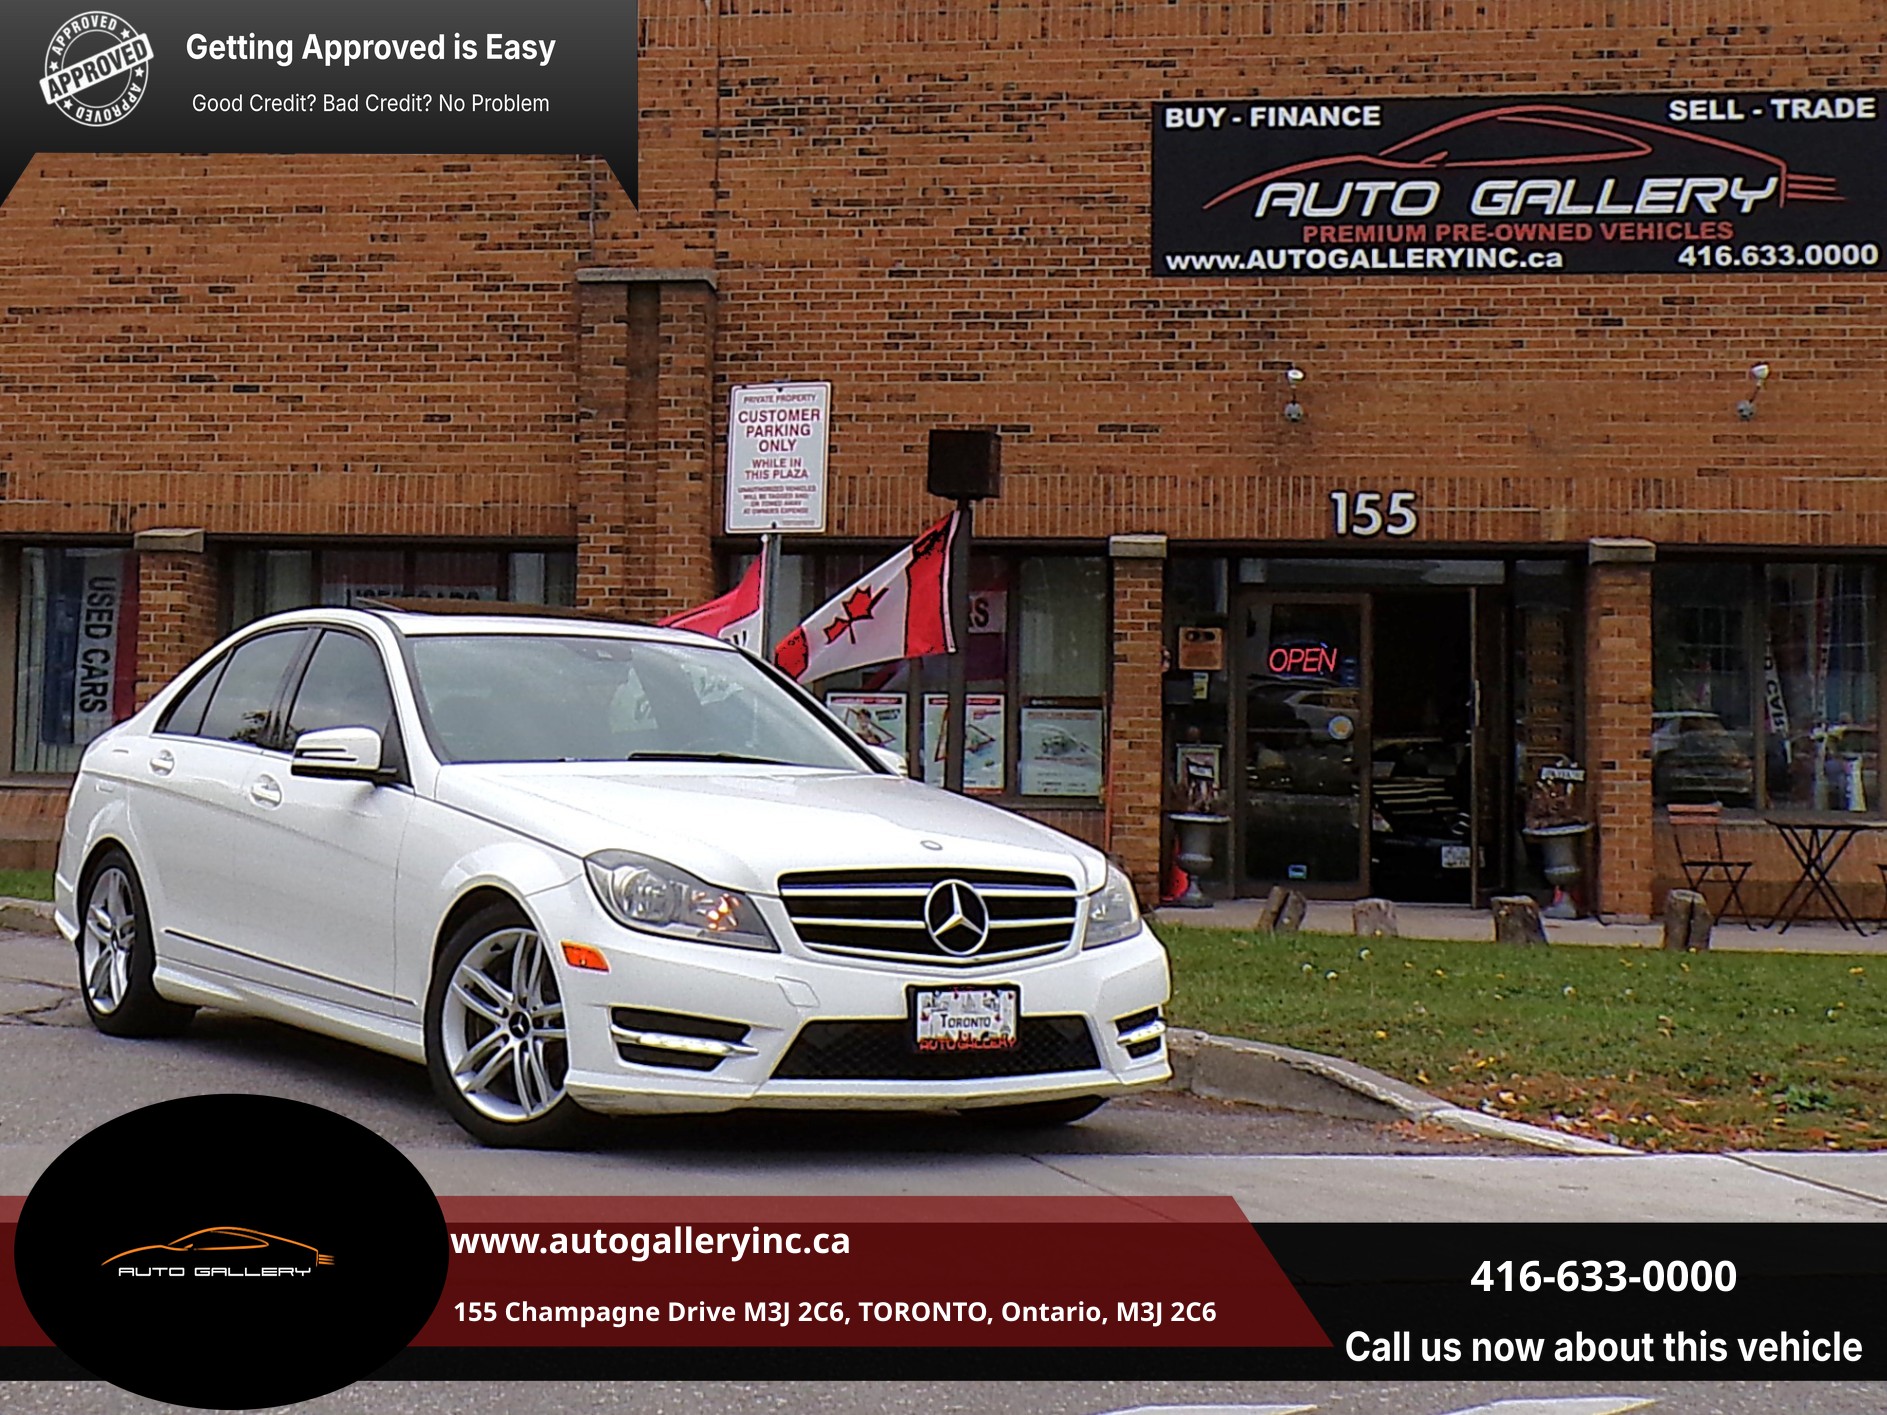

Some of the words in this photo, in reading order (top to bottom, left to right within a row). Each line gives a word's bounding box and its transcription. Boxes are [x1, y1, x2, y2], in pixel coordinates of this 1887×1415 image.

[1165, 107, 1227, 128] BUY
[1250, 105, 1381, 127] FINANCE
[1669, 99, 1745, 121] SELL
[1771, 97, 1876, 119] TRADE
[1255, 181, 1440, 217] AUTO
[1471, 177, 1778, 216] GALLERY
[1303, 223, 1426, 243] PREMIUM
[1436, 222, 1592, 242] PRE-OWNED
[1600, 221, 1734, 240] VEHICLES
[1165, 248, 1563, 270] www.AUTOGALLERYINC.ca
[1678, 244, 1879, 266] 416.633.0000
[744, 395, 773, 403] PRIVATE
[776, 394, 817, 403] PROPERTY
[738, 409, 821, 423] CUSTOMER
[746, 424, 811, 438] PARKING
[759, 439, 797, 452] ONLY
[745, 470, 769, 480] THIS
[773, 469, 808, 479] PLAZA
[752, 458, 786, 469] WHILE
[790, 458, 802, 467] IN
[1331, 492, 1417, 535] 155
[84, 576, 116, 640] USED
[1269, 647, 1337, 672] OPEN
[79, 648, 111, 713] CARS
